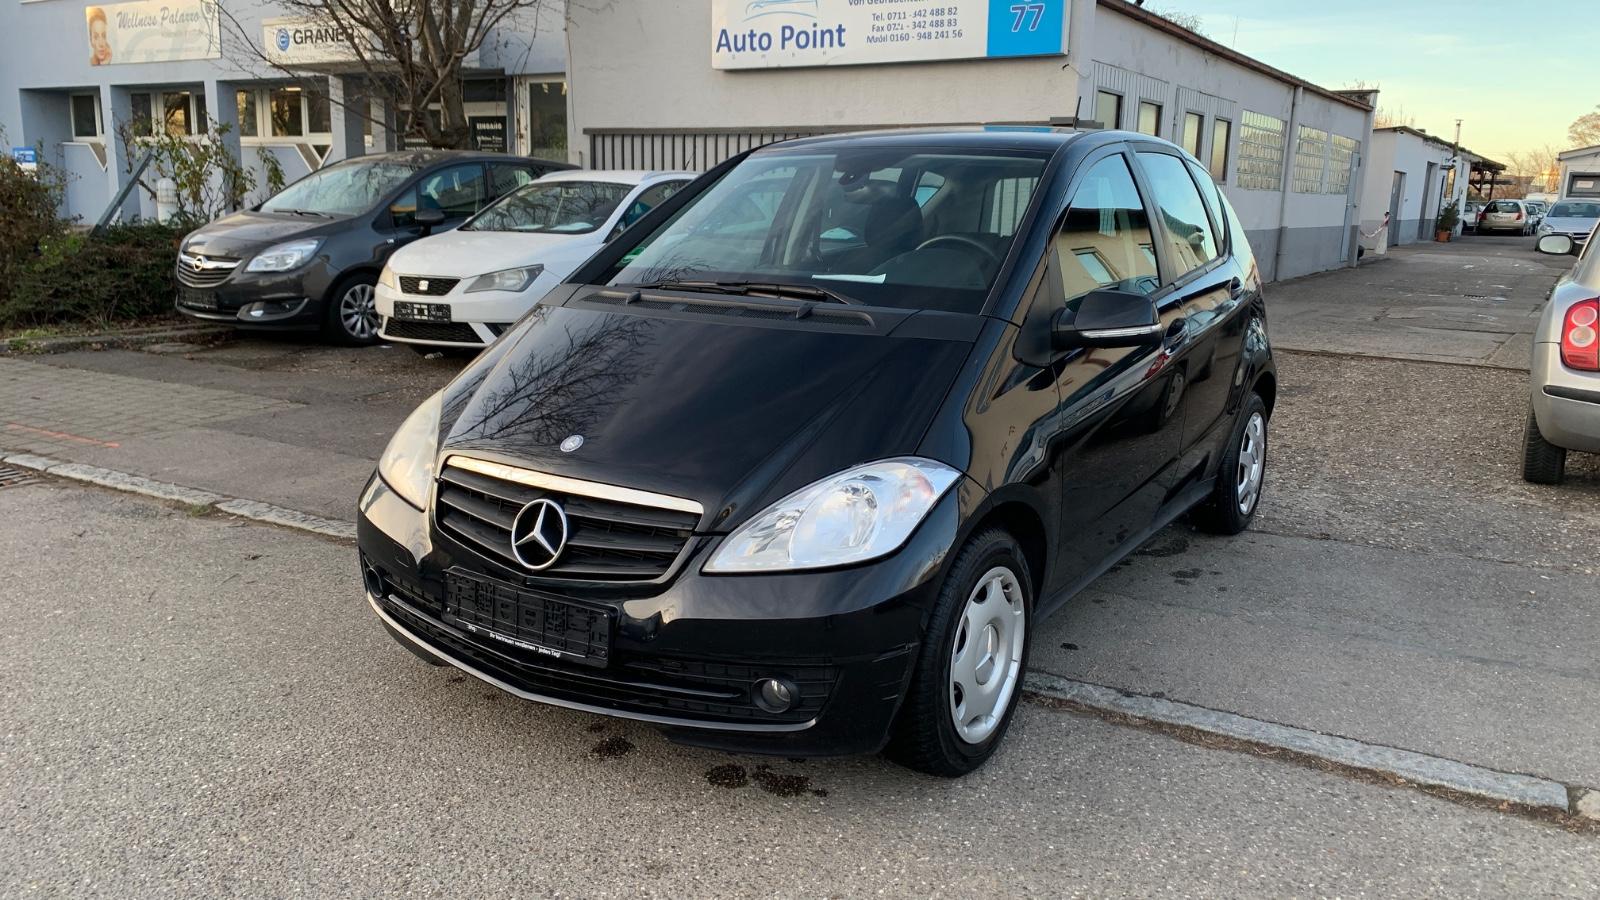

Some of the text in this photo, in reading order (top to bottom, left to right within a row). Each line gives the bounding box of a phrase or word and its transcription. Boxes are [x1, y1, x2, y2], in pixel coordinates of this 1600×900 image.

[116, 6, 201, 29] Wellness Palazzo
[872, 13, 885, 21] Tel.
[887, 11, 907, 21] 0711
[929, 7, 945, 17] 488
[947, 7, 958, 16] 82
[1010, 3, 1045, 32] 77
[872, 24, 885, 32] Fax
[912, 20, 927, 30] 342
[929, 19, 945, 28] 488
[947, 18, 958, 27] 83
[293, 28, 355, 45] GRANE
[716, 22, 846, 53] Auto Point
[890, 33, 910, 42] 0160
[917, 31, 932, 41] 948
[934, 30, 949, 40] 241
[952, 29, 963, 39] 56
